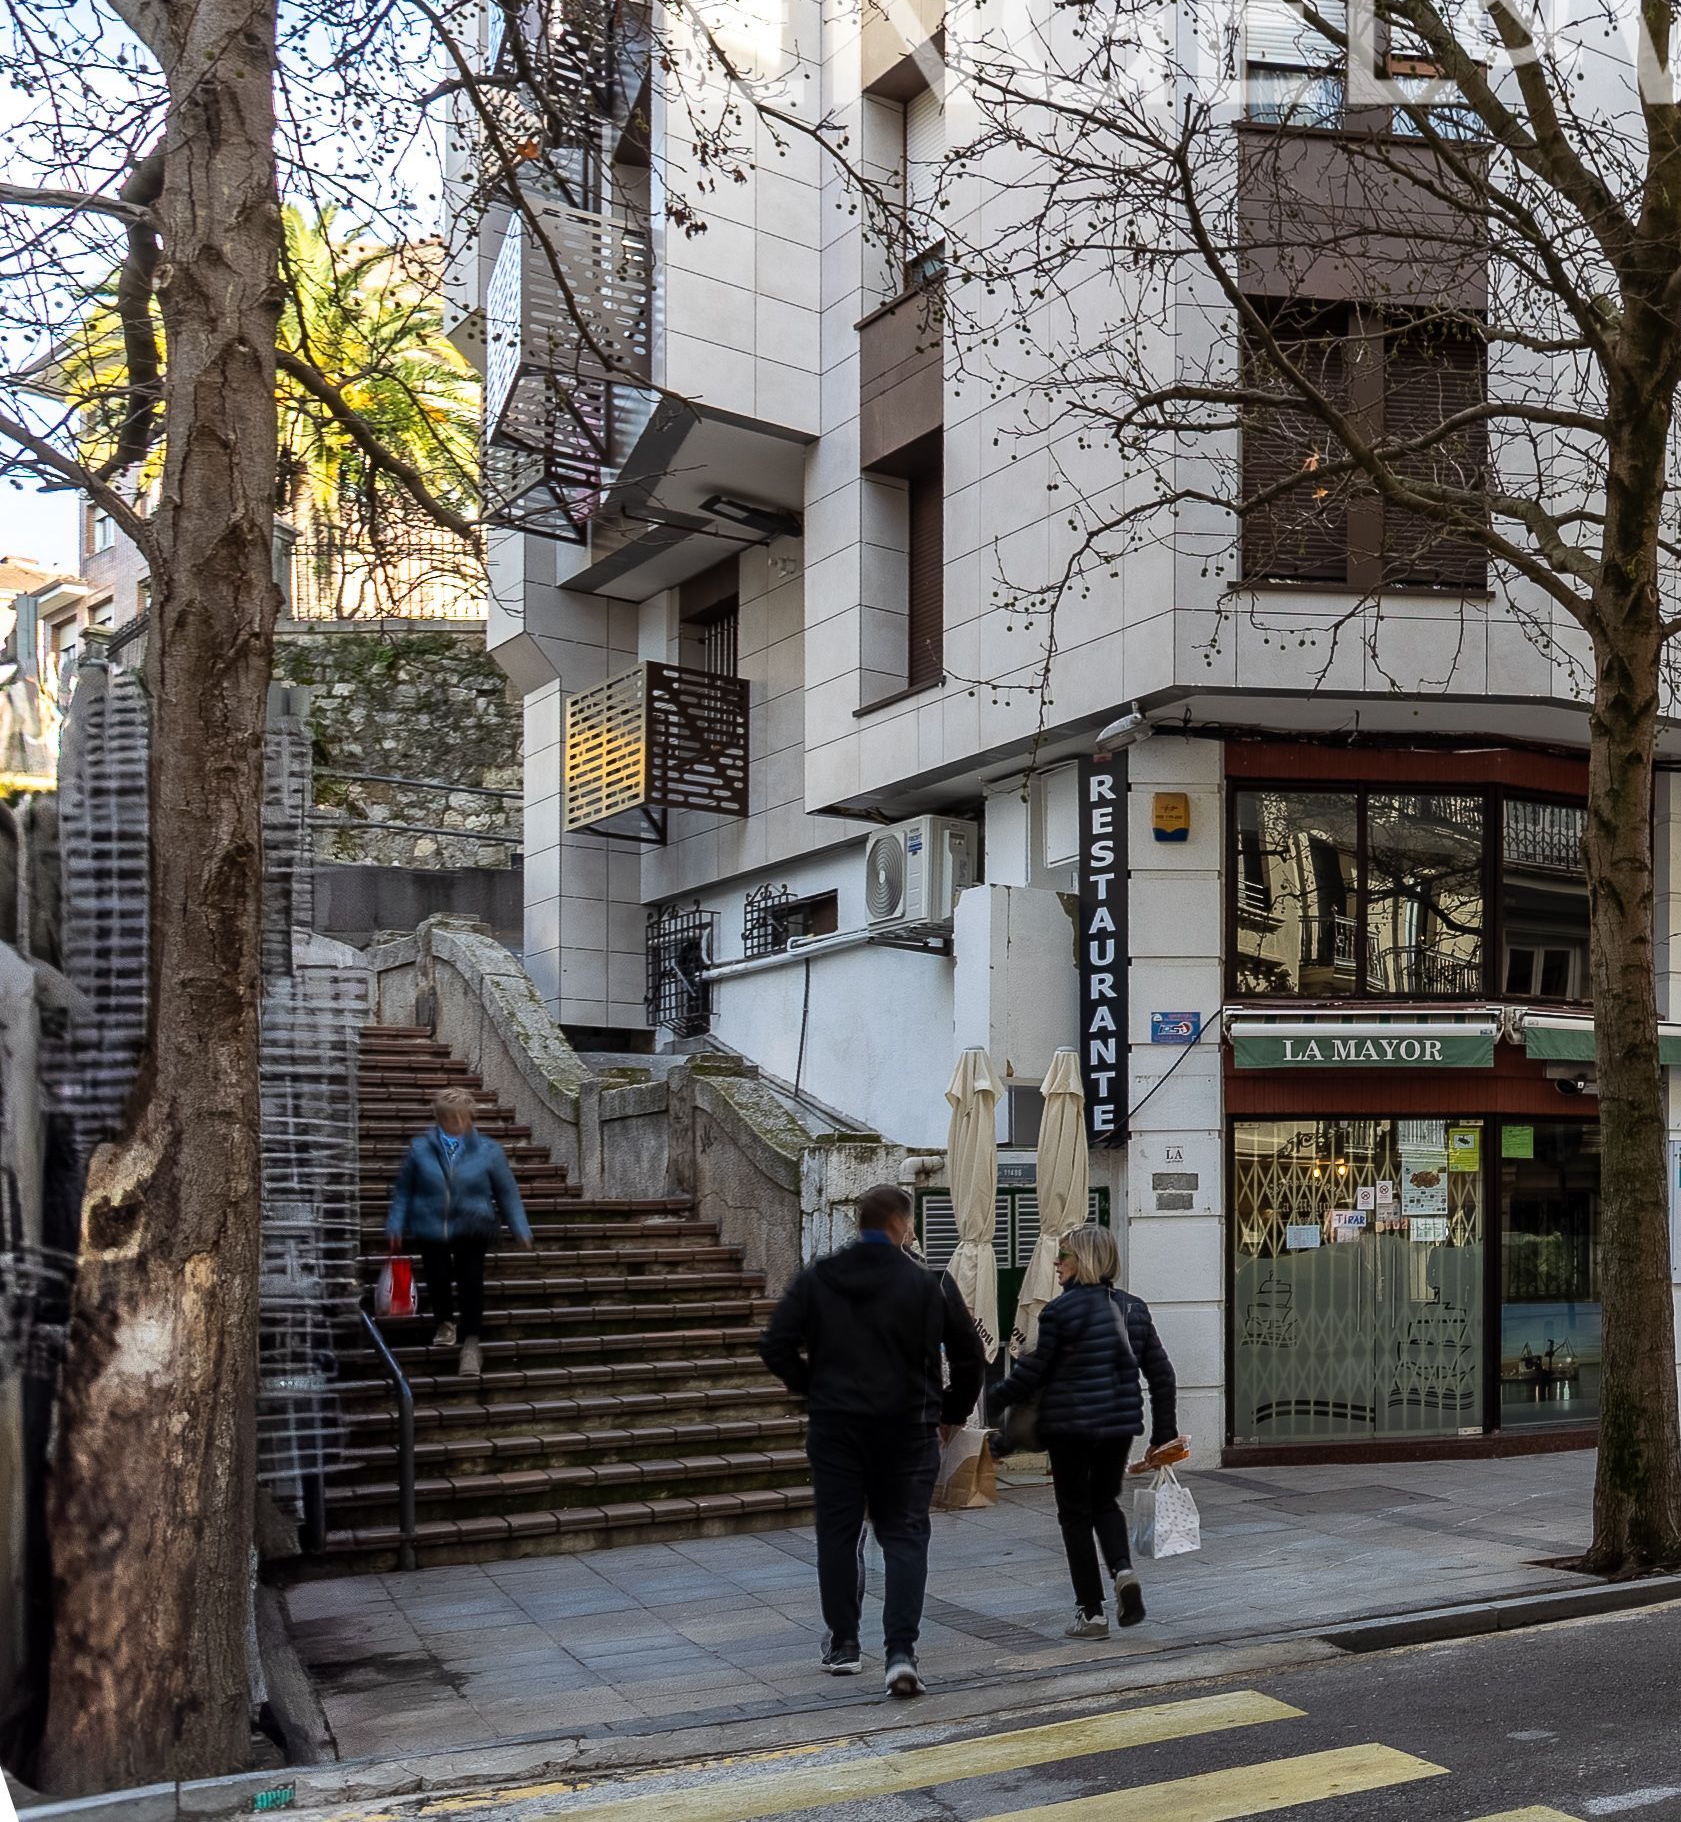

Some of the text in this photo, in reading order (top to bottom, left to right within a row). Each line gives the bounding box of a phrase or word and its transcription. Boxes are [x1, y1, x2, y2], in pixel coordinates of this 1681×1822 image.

[1088, 774, 1117, 1131] RESTAURANTE
[1282, 1039, 1443, 1061] LA MAYOR
[1166, 1149, 1183, 1160] LA
[1335, 1213, 1365, 1225] TIRAR
